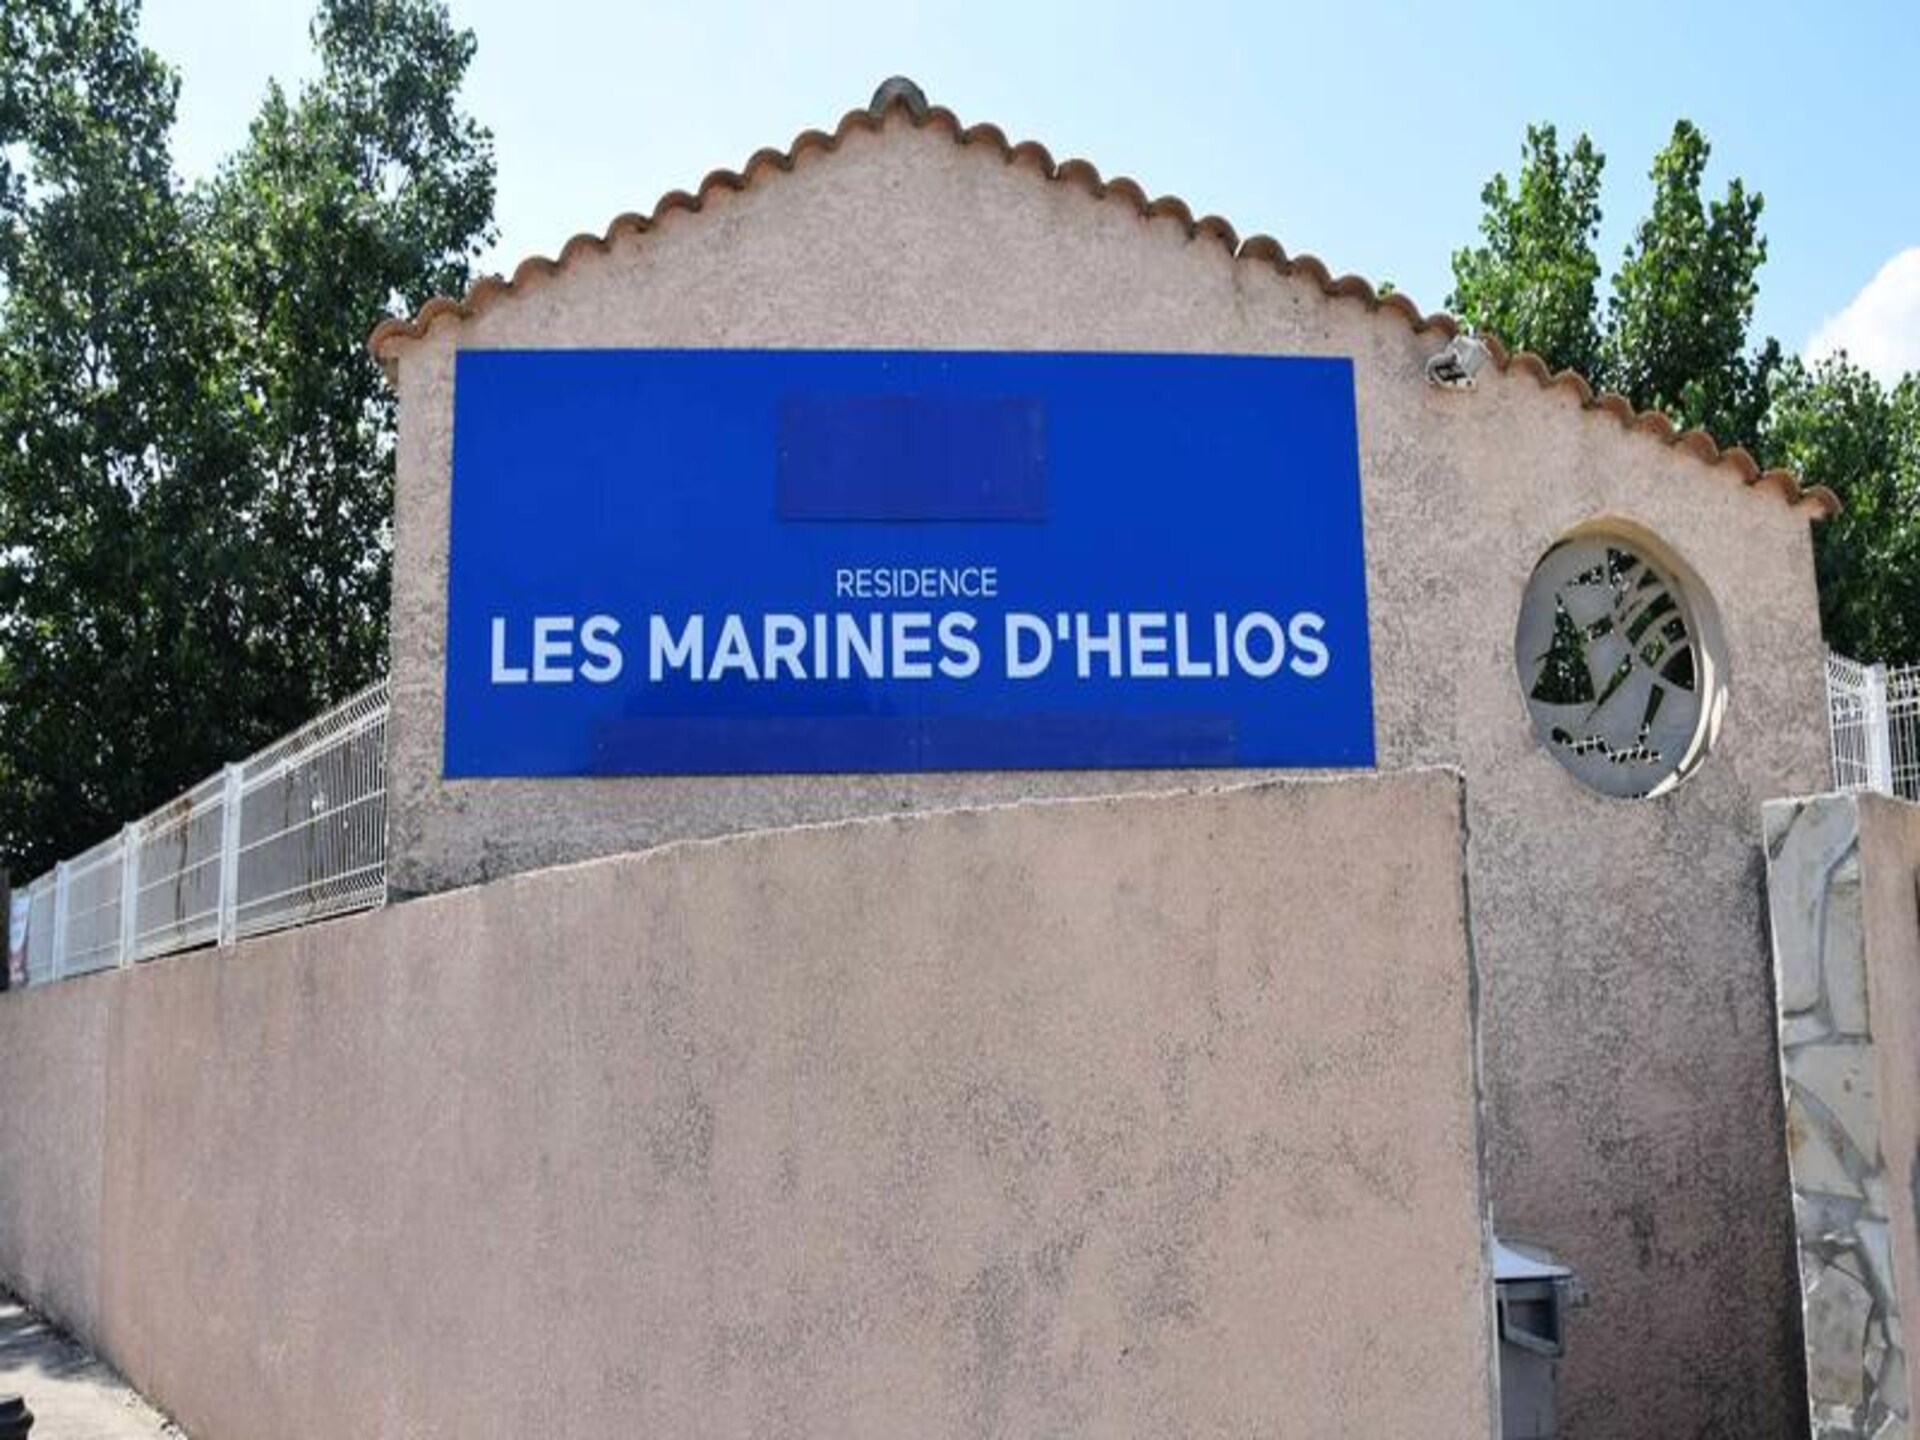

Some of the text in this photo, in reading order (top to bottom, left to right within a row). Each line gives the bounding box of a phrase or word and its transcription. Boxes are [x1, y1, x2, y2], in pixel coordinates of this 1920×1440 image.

[836, 568, 998, 598] RESIDENCE
[490, 611, 1330, 684] LES MARINES D'HELIOS
